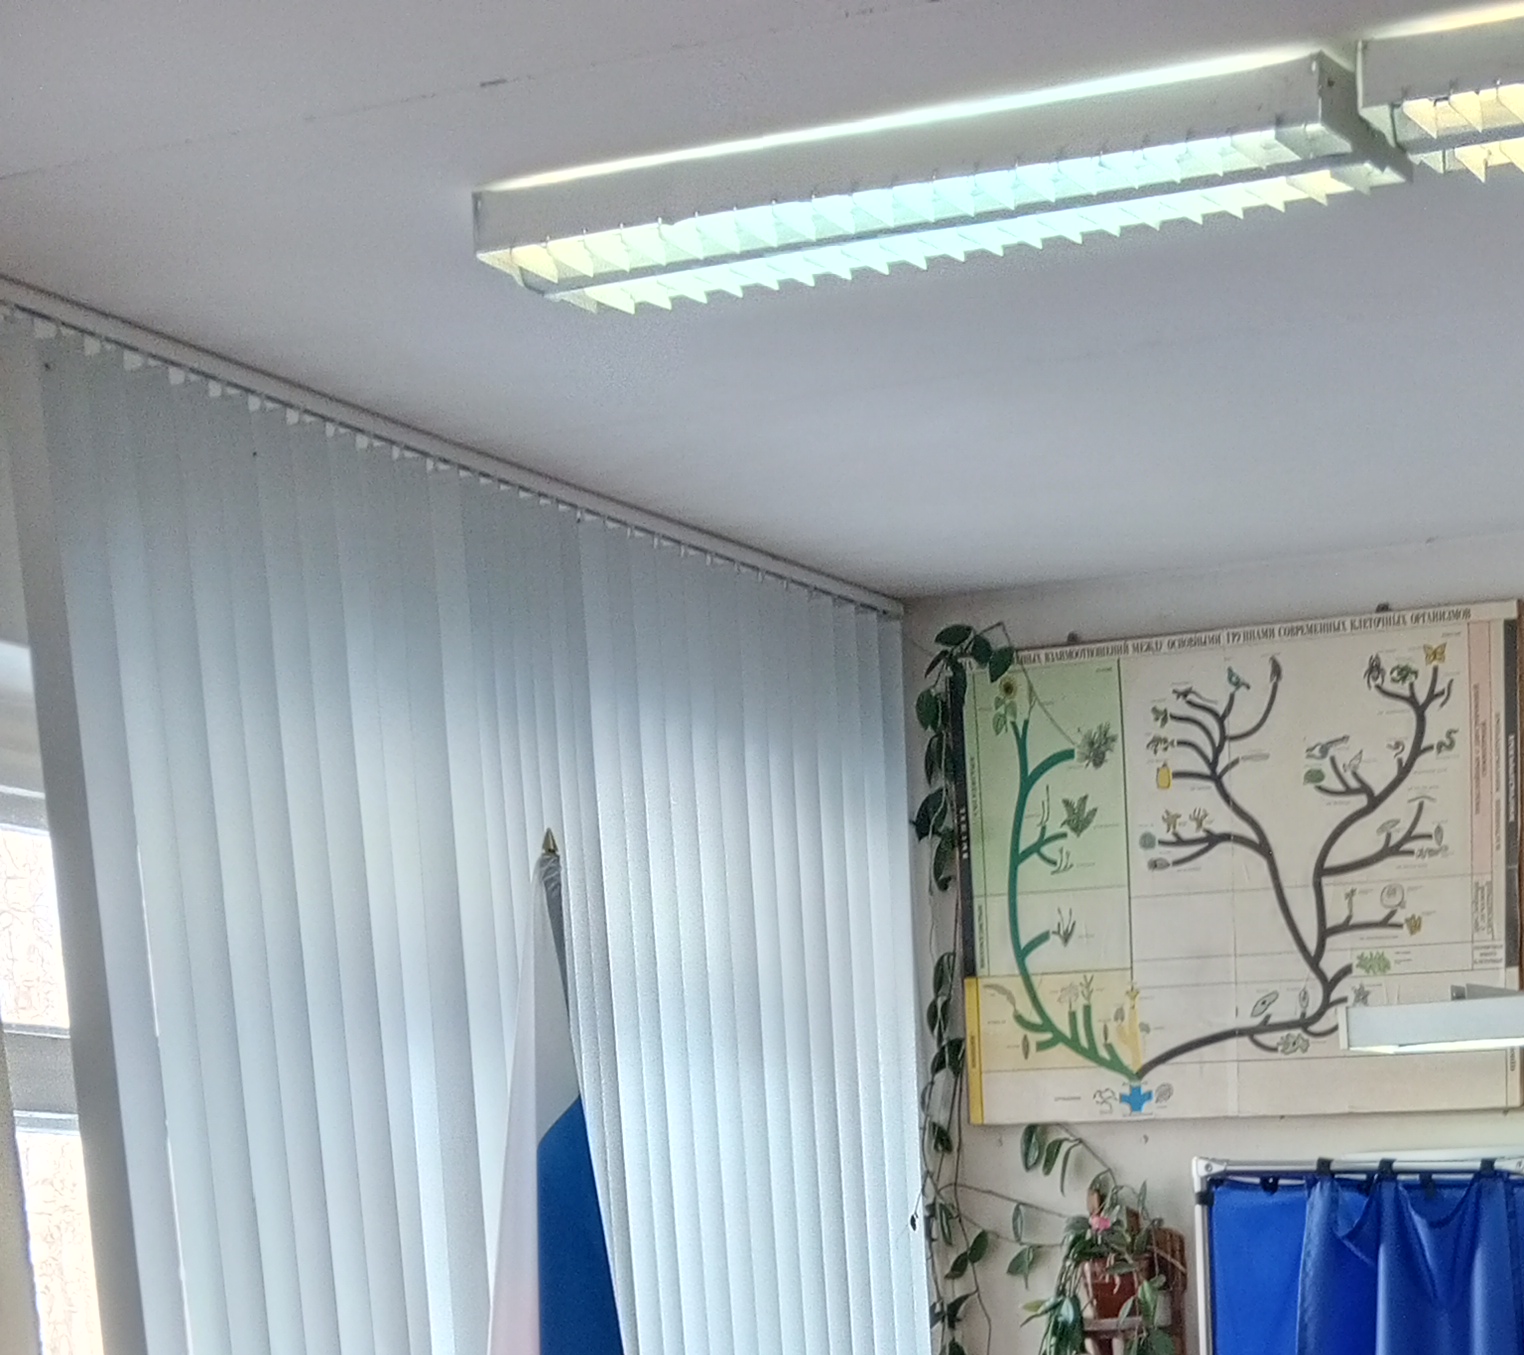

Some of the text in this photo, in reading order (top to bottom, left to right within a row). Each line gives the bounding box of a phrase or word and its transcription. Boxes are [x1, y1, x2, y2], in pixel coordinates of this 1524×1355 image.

[1278, 619, 1348, 638] СОВРЕМЕННЫХ
[1350, 613, 1407, 632] КЛЕТОЧНЫХ
[1410, 607, 1472, 626] ОРГАНИЗМОВ
